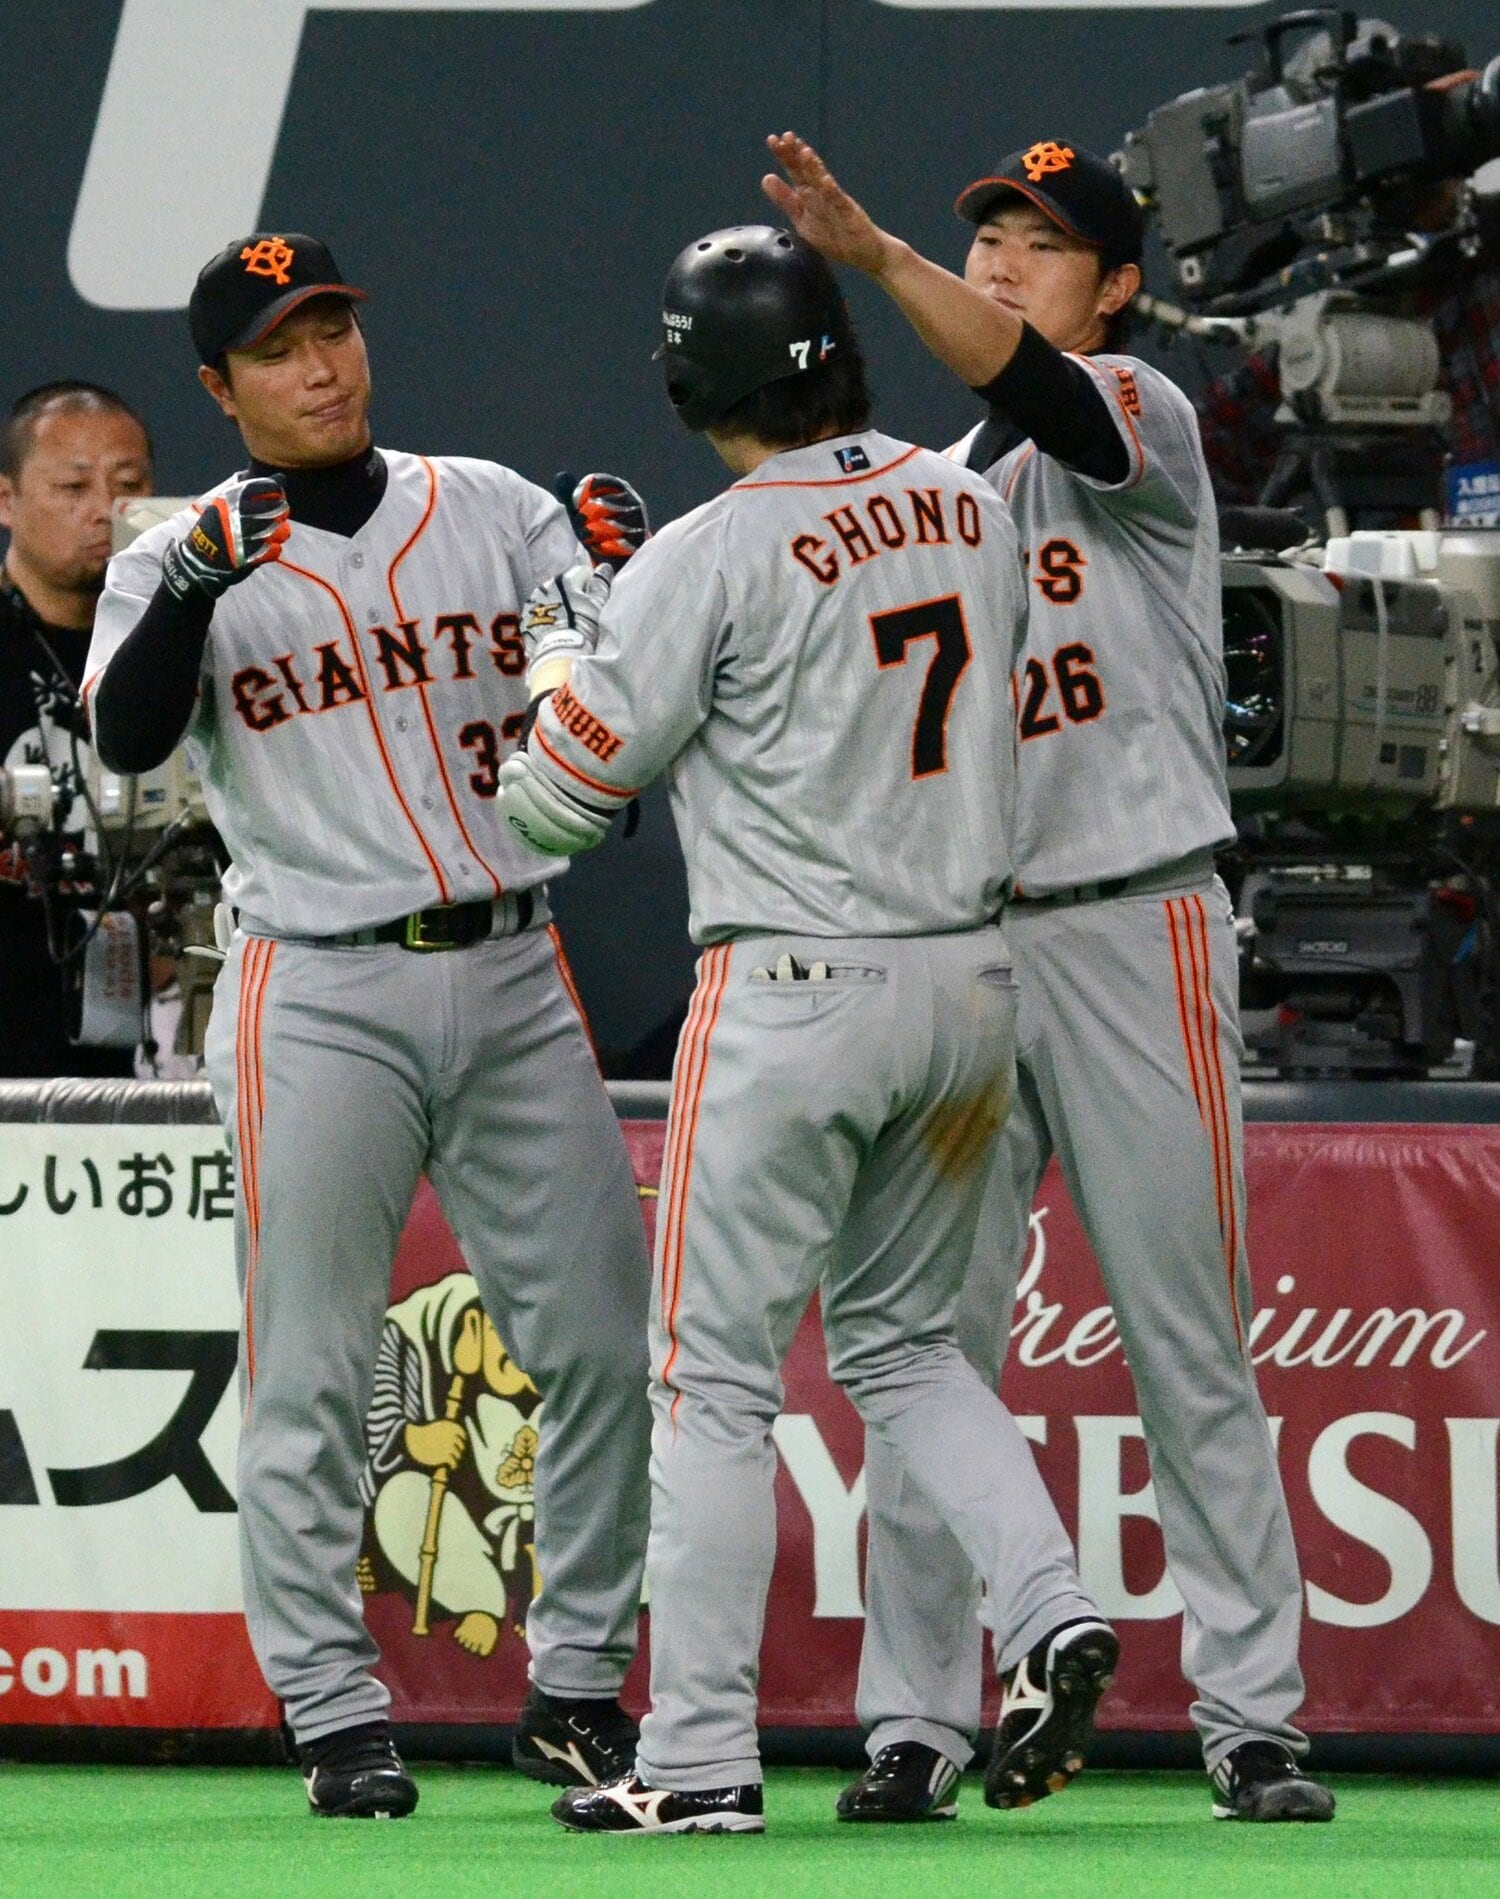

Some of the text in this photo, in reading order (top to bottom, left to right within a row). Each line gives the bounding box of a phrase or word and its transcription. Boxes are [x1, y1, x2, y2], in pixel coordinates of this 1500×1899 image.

[666, 329, 682, 345] 日本
[789, 339, 811, 370] 7
[791, 487, 982, 585] CHONO
[1024, 537, 1089, 606] S
[231, 612, 528, 732] GIANTS
[867, 592, 974, 781] 7
[1020, 641, 1107, 742] 26
[1009, 1206, 1487, 1370] reium
[772, 1410, 1500, 1628] YBS
